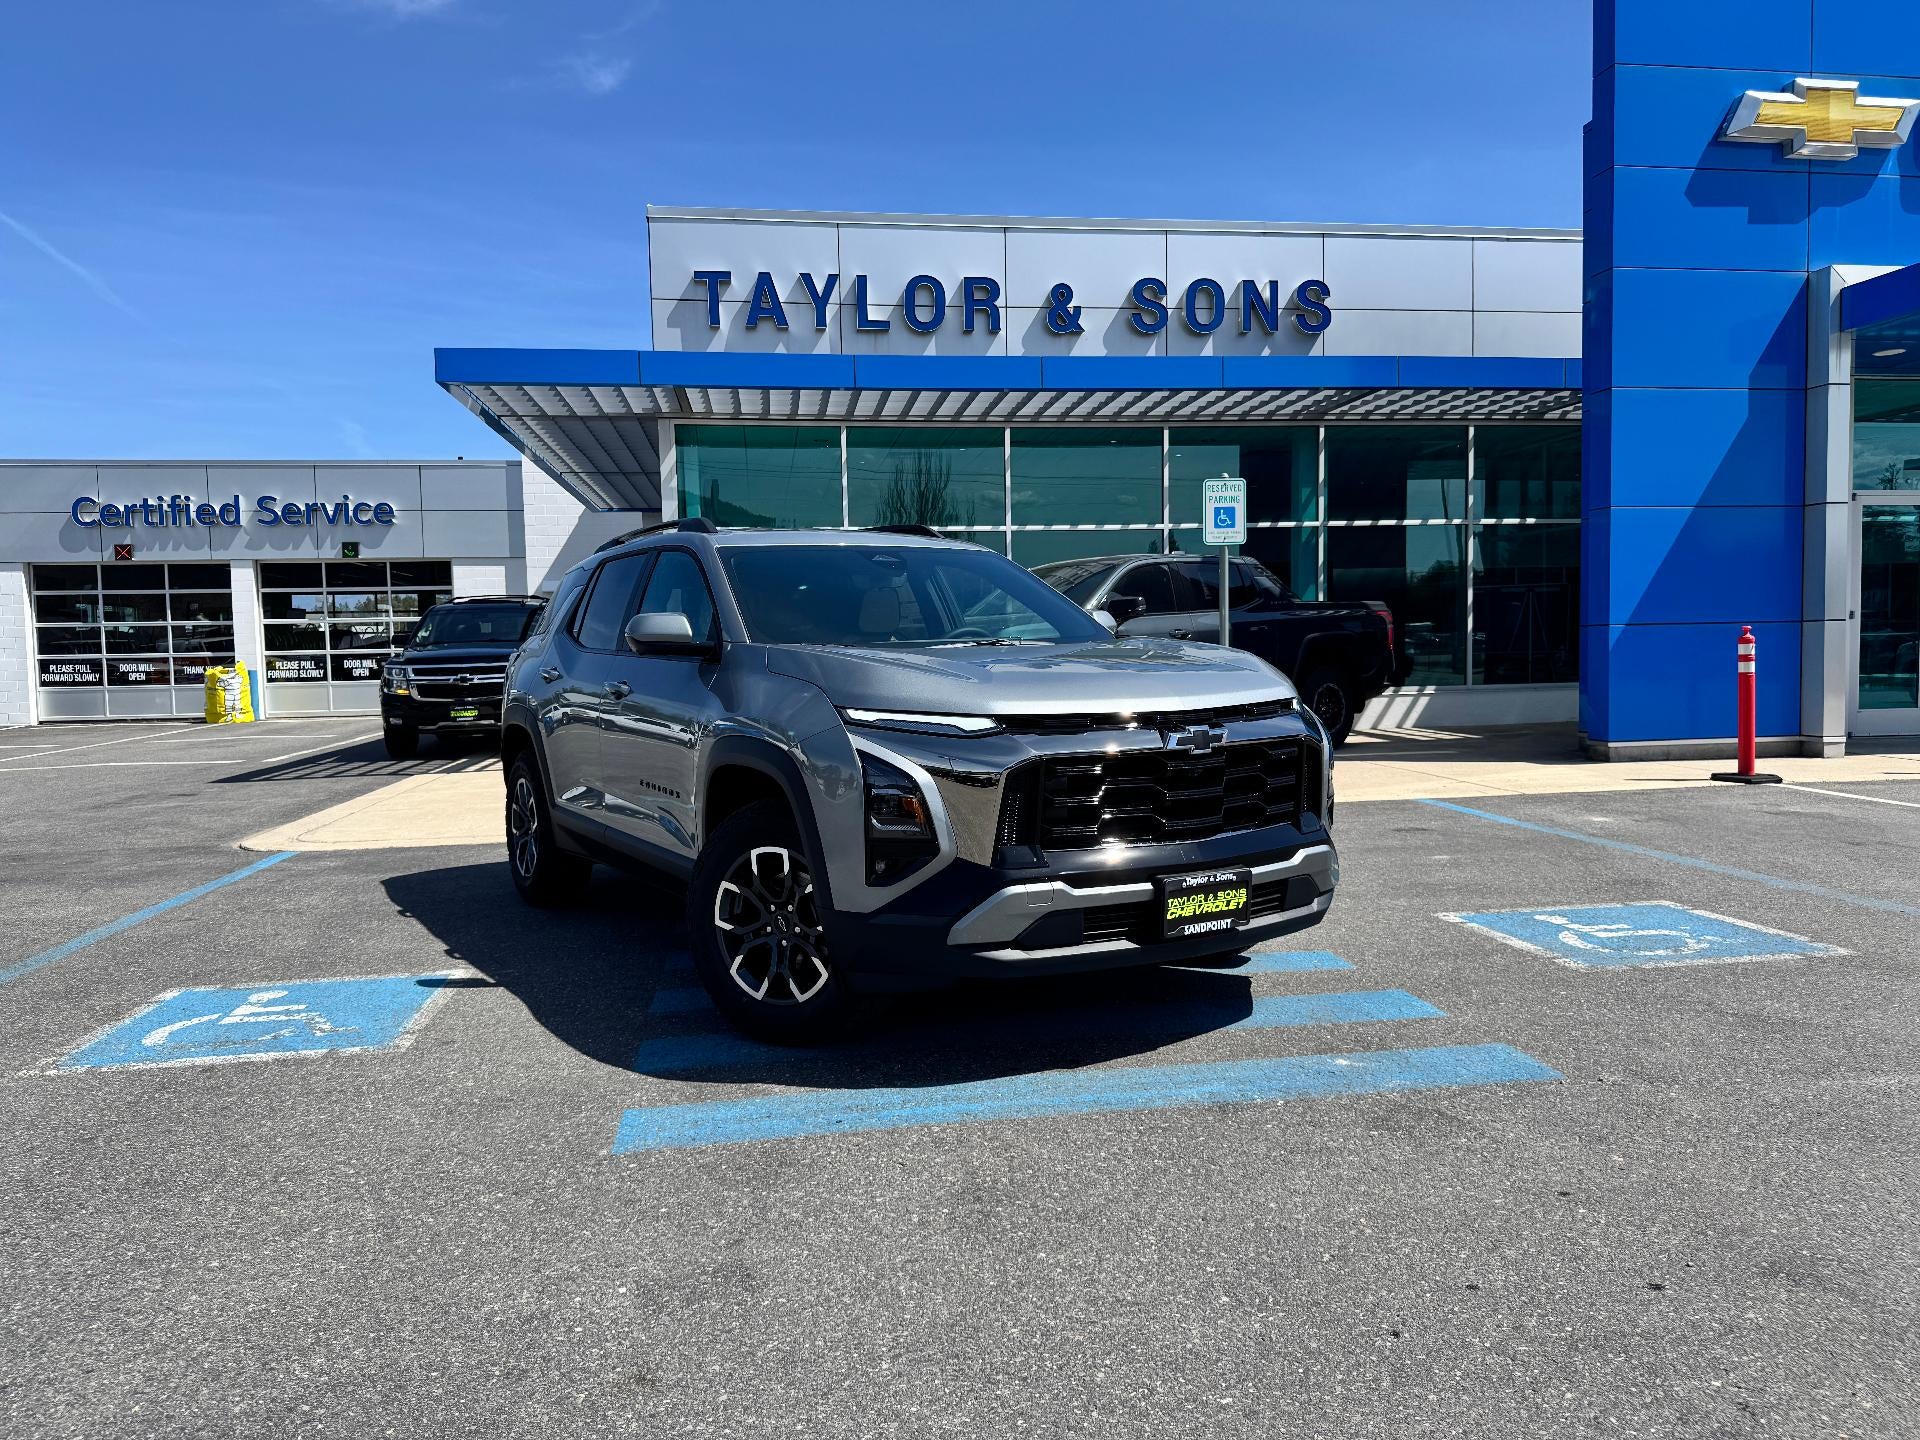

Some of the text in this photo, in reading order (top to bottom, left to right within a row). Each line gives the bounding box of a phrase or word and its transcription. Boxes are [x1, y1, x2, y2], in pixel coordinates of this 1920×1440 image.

[693, 269, 1333, 336] TAYLOR & SONS
[1207, 484, 1242, 493] RESERVED
[1208, 495, 1241, 504] PARKING
[71, 494, 396, 528] Certified Service
[119, 663, 154, 672] DOOR WILL
[275, 660, 316, 670] PLEASE PULL
[343, 658, 378, 668] DOOR WILL
[49, 664, 91, 673] PLEASE PULL
[183, 666, 205, 675] THANK
[352, 668, 369, 677] OPEN
[41, 673, 100, 682] FORWARD SLOWLY
[128, 672, 146, 681] OPEN
[267, 669, 324, 679] FORWARD SLOWLY
[1186, 877, 1208, 886] Taylor
[1215, 873, 1234, 882] Sons
[1167, 888, 1247, 908] TAYLOR & SONS
[1166, 898, 1247, 919] CHEVROLET
[1184, 919, 1231, 935] SANDPOINT
